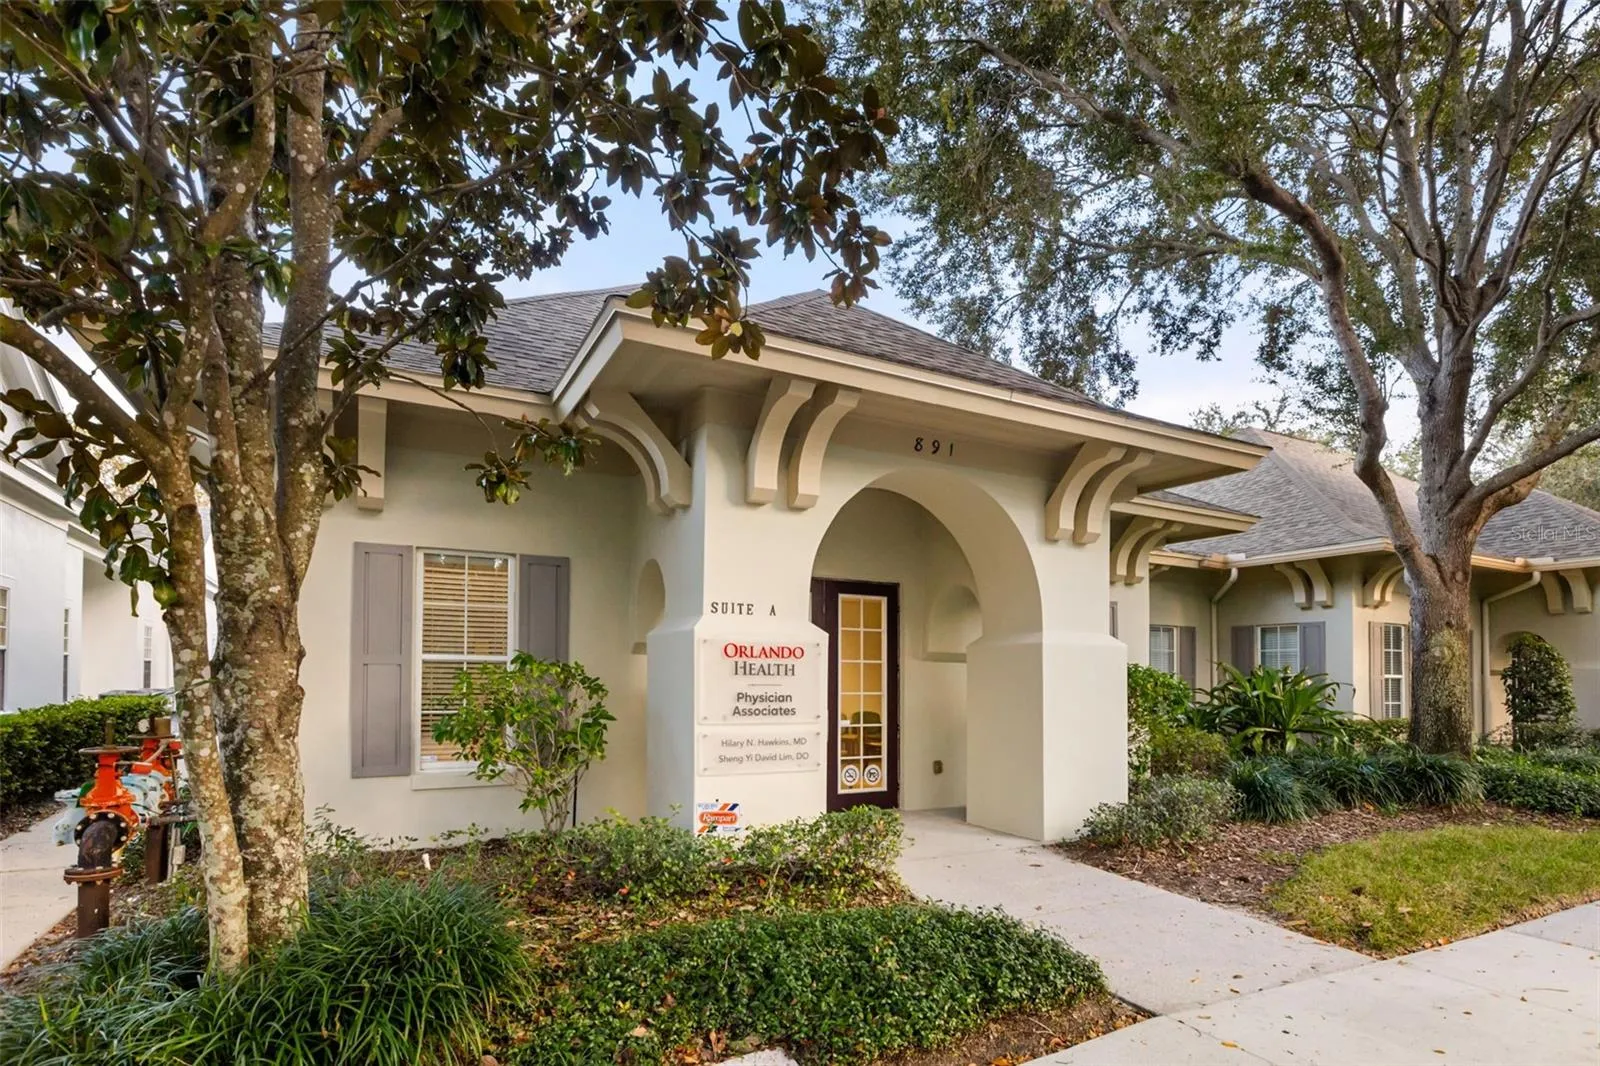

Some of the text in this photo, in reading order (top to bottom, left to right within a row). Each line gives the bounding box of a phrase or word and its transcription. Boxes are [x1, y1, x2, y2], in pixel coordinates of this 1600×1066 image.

[914, 436, 954, 457] 891
[710, 602, 776, 617] SUITE A
[723, 642, 805, 660] ORLANDO
[734, 661, 796, 677] HEALTH
[736, 691, 793, 705] Physician
[732, 704, 797, 717] Associates
[721, 739, 745, 748] Hilary
[757, 738, 792, 747] Hawkins,
[793, 737, 808, 746] MD
[718, 754, 744, 765] Sheng
[745, 754, 753, 762] Yi
[754, 753, 777, 763] David
[795, 752, 810, 761] DO
